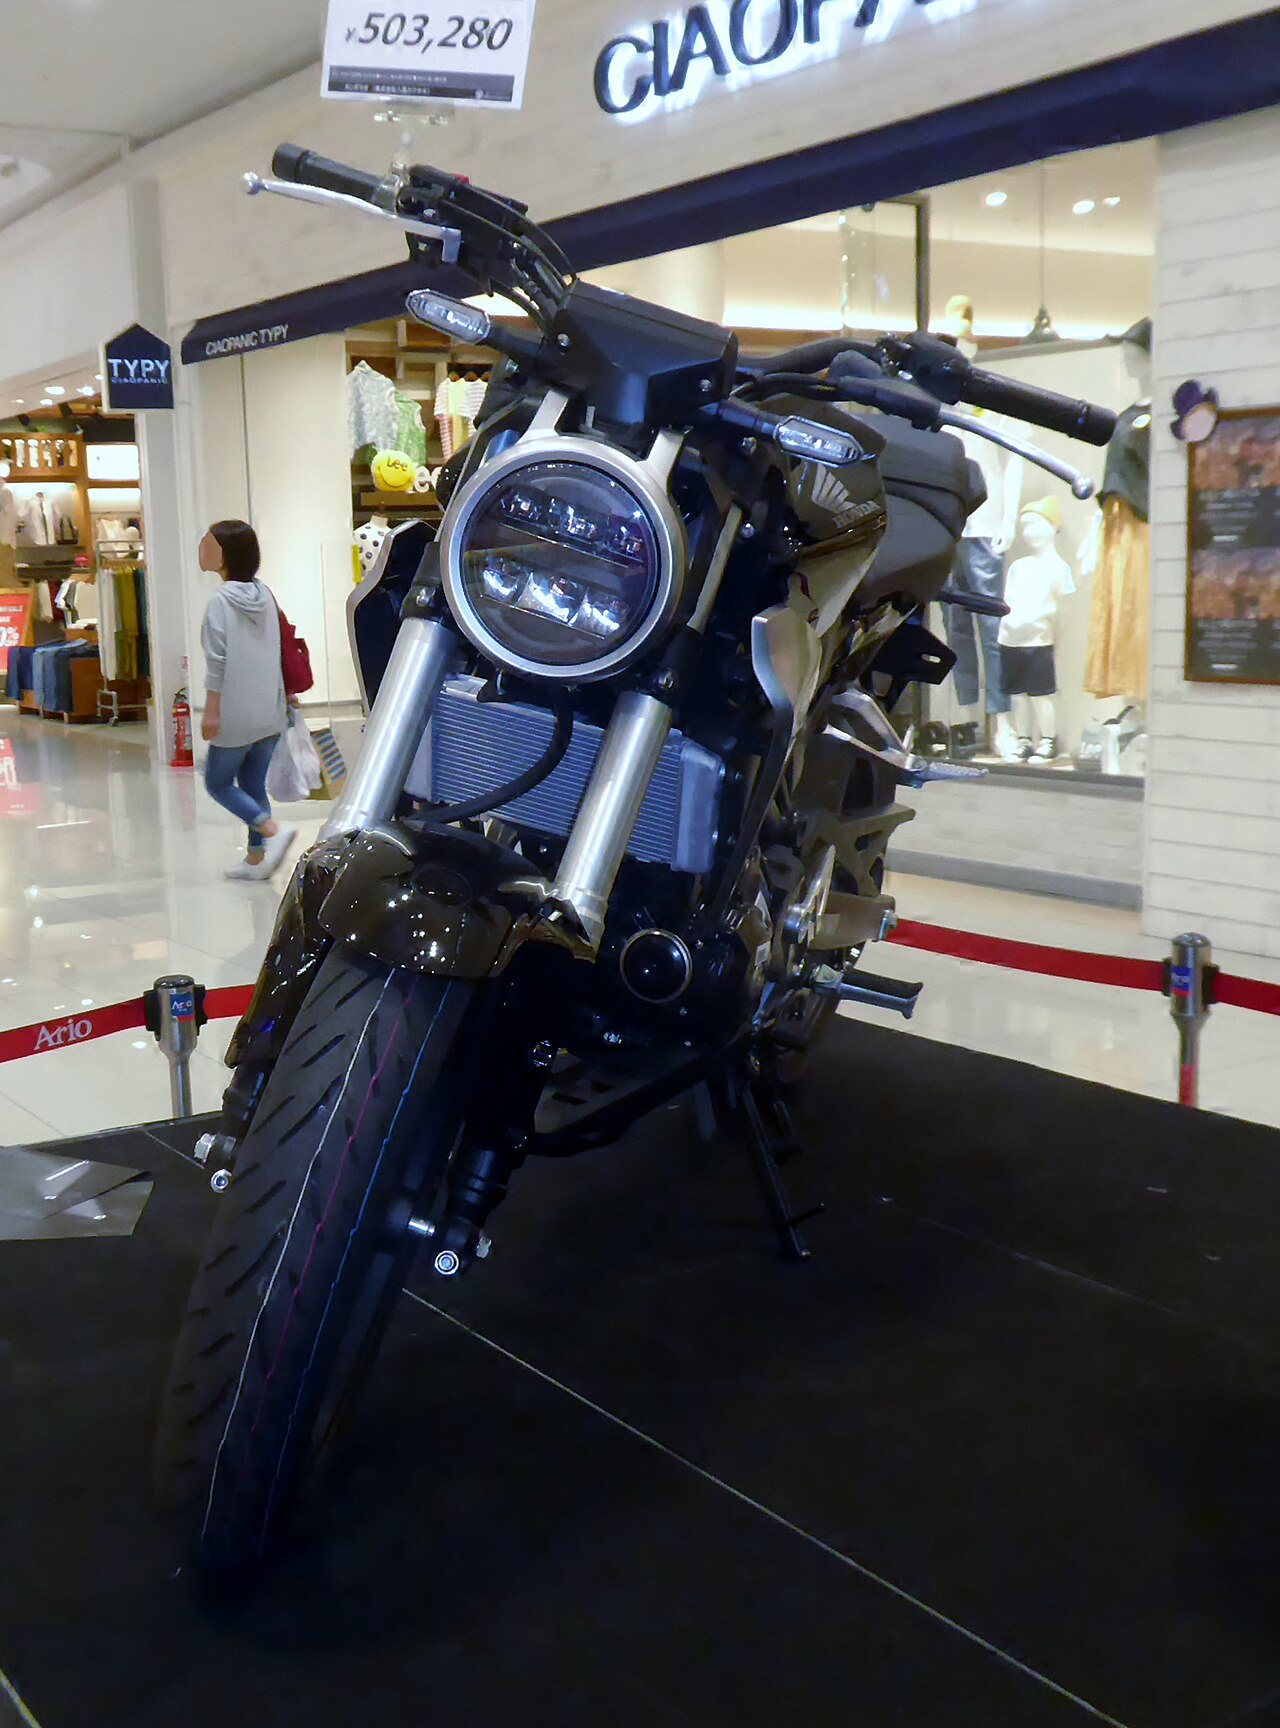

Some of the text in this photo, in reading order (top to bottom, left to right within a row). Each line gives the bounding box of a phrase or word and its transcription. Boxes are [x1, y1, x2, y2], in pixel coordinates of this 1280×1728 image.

[259, 323, 289, 344] TYPY
[108, 358, 169, 378] TYPY
[386, 456, 408, 472] Lee
[34, 1019, 93, 1050] Ario
